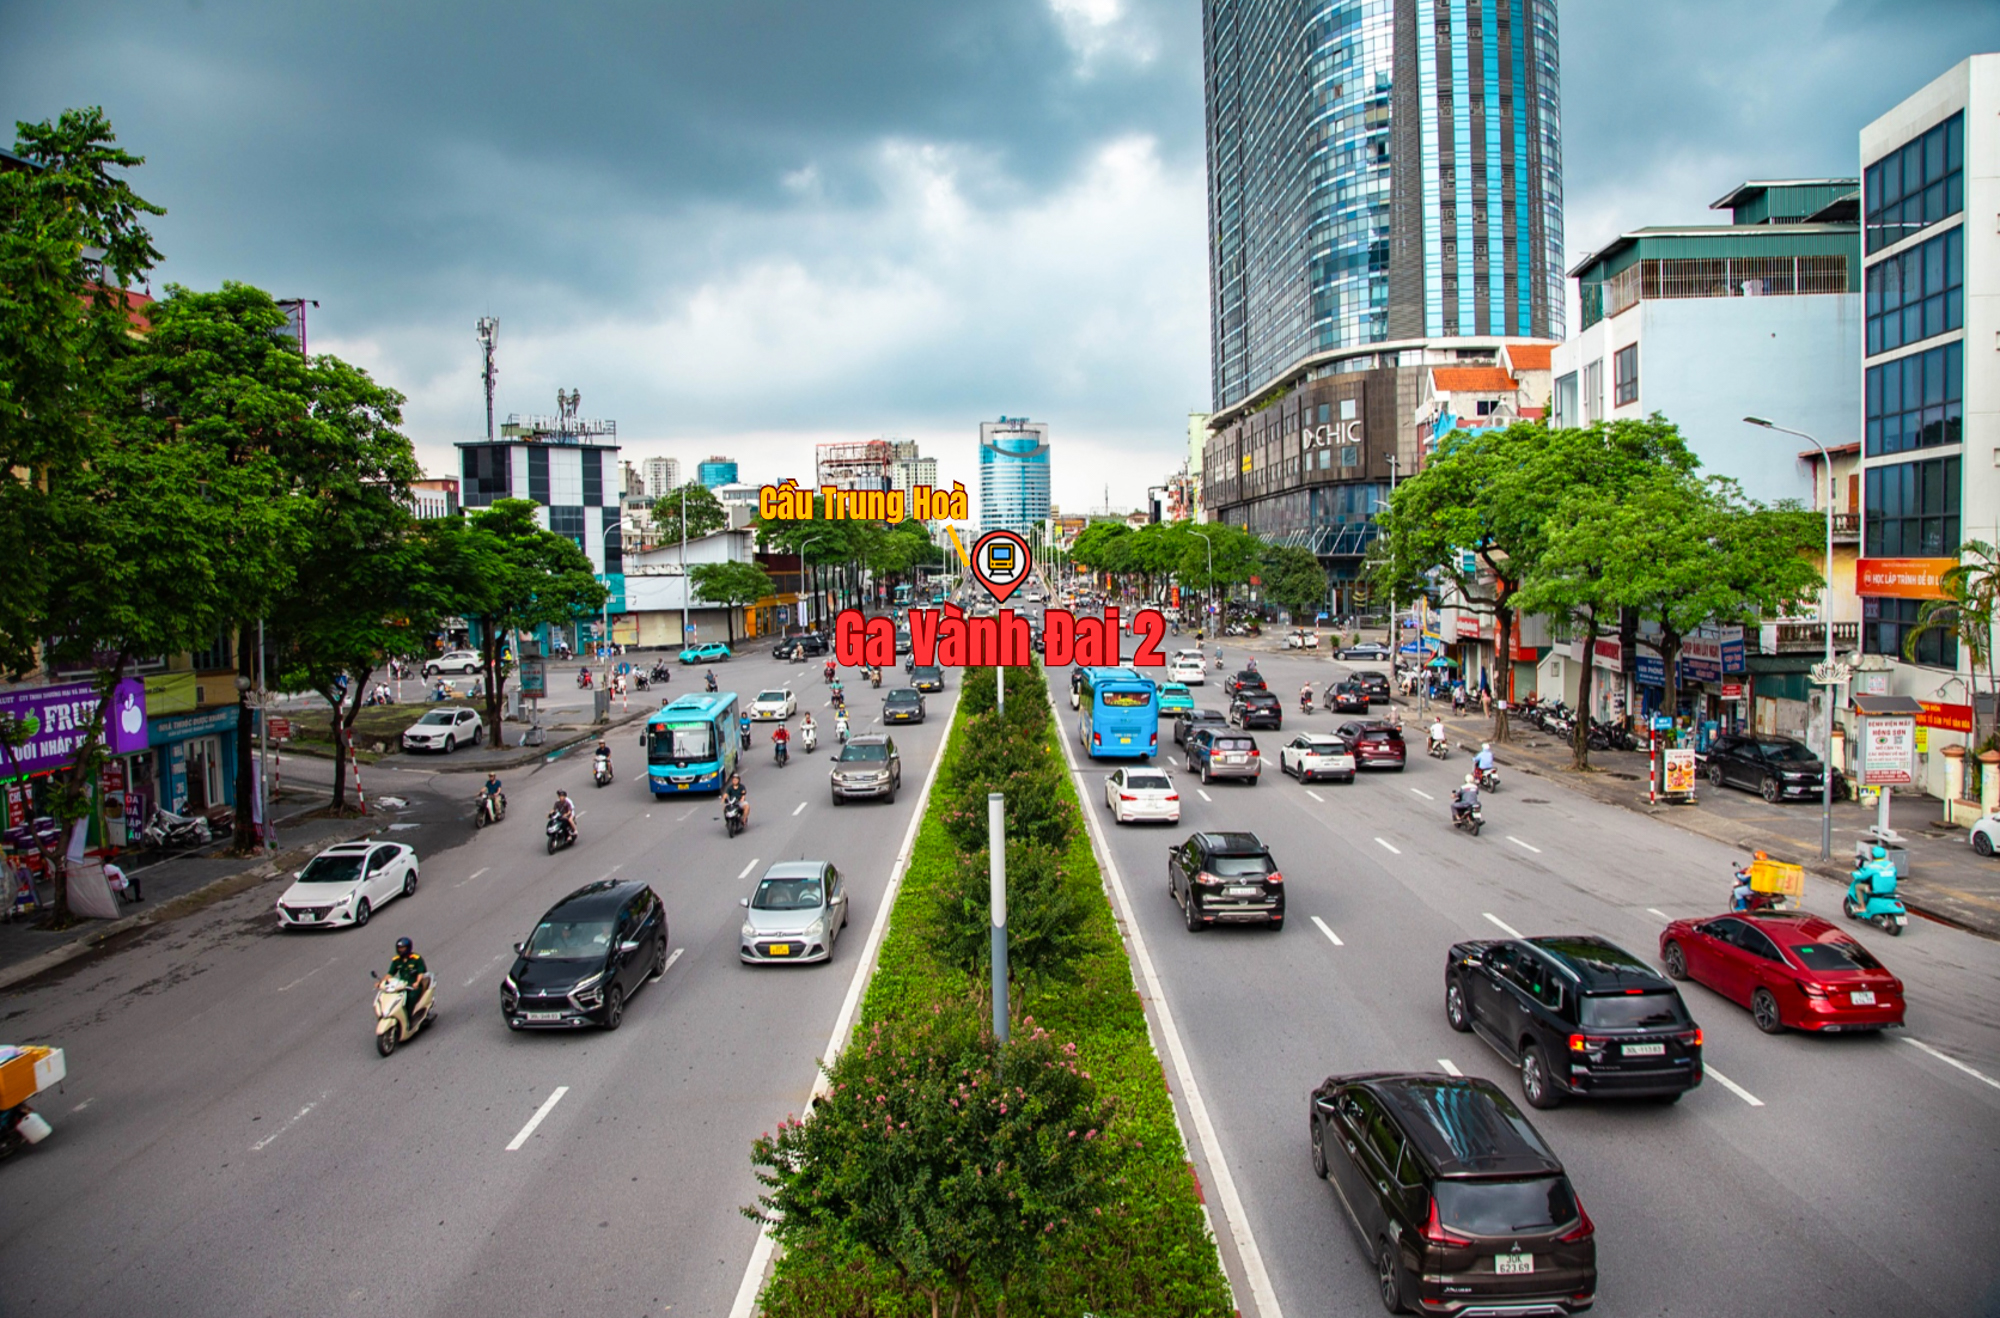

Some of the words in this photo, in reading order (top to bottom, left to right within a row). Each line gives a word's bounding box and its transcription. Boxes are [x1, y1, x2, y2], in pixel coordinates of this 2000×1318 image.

[1873, 574, 1885, 586] HỌC
[1885, 572, 1897, 587] LẬP
[1897, 571, 1917, 585] TRÌNH
